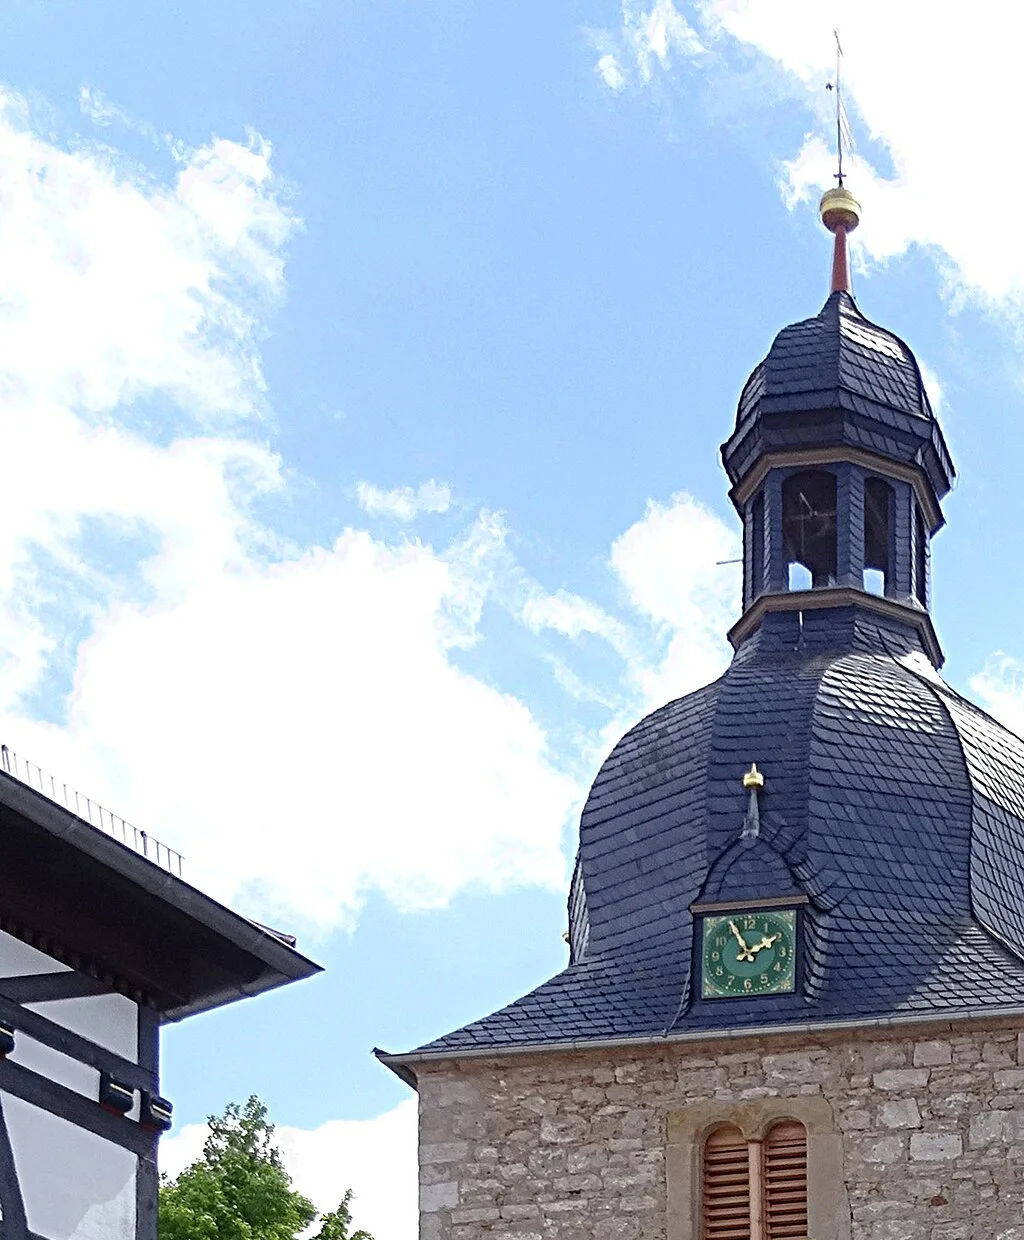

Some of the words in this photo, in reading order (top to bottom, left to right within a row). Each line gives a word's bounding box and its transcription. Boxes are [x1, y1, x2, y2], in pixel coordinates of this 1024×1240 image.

[744, 920, 756, 929] 12
[715, 937, 727, 946] 10
[711, 951, 719, 961] 9
[779, 947, 786, 957] 3
[773, 962, 780, 971] 4
[715, 967, 723, 976] 8
[728, 976, 735, 985] 7
[760, 974, 768, 983] 5
[743, 979, 752, 989] 6
